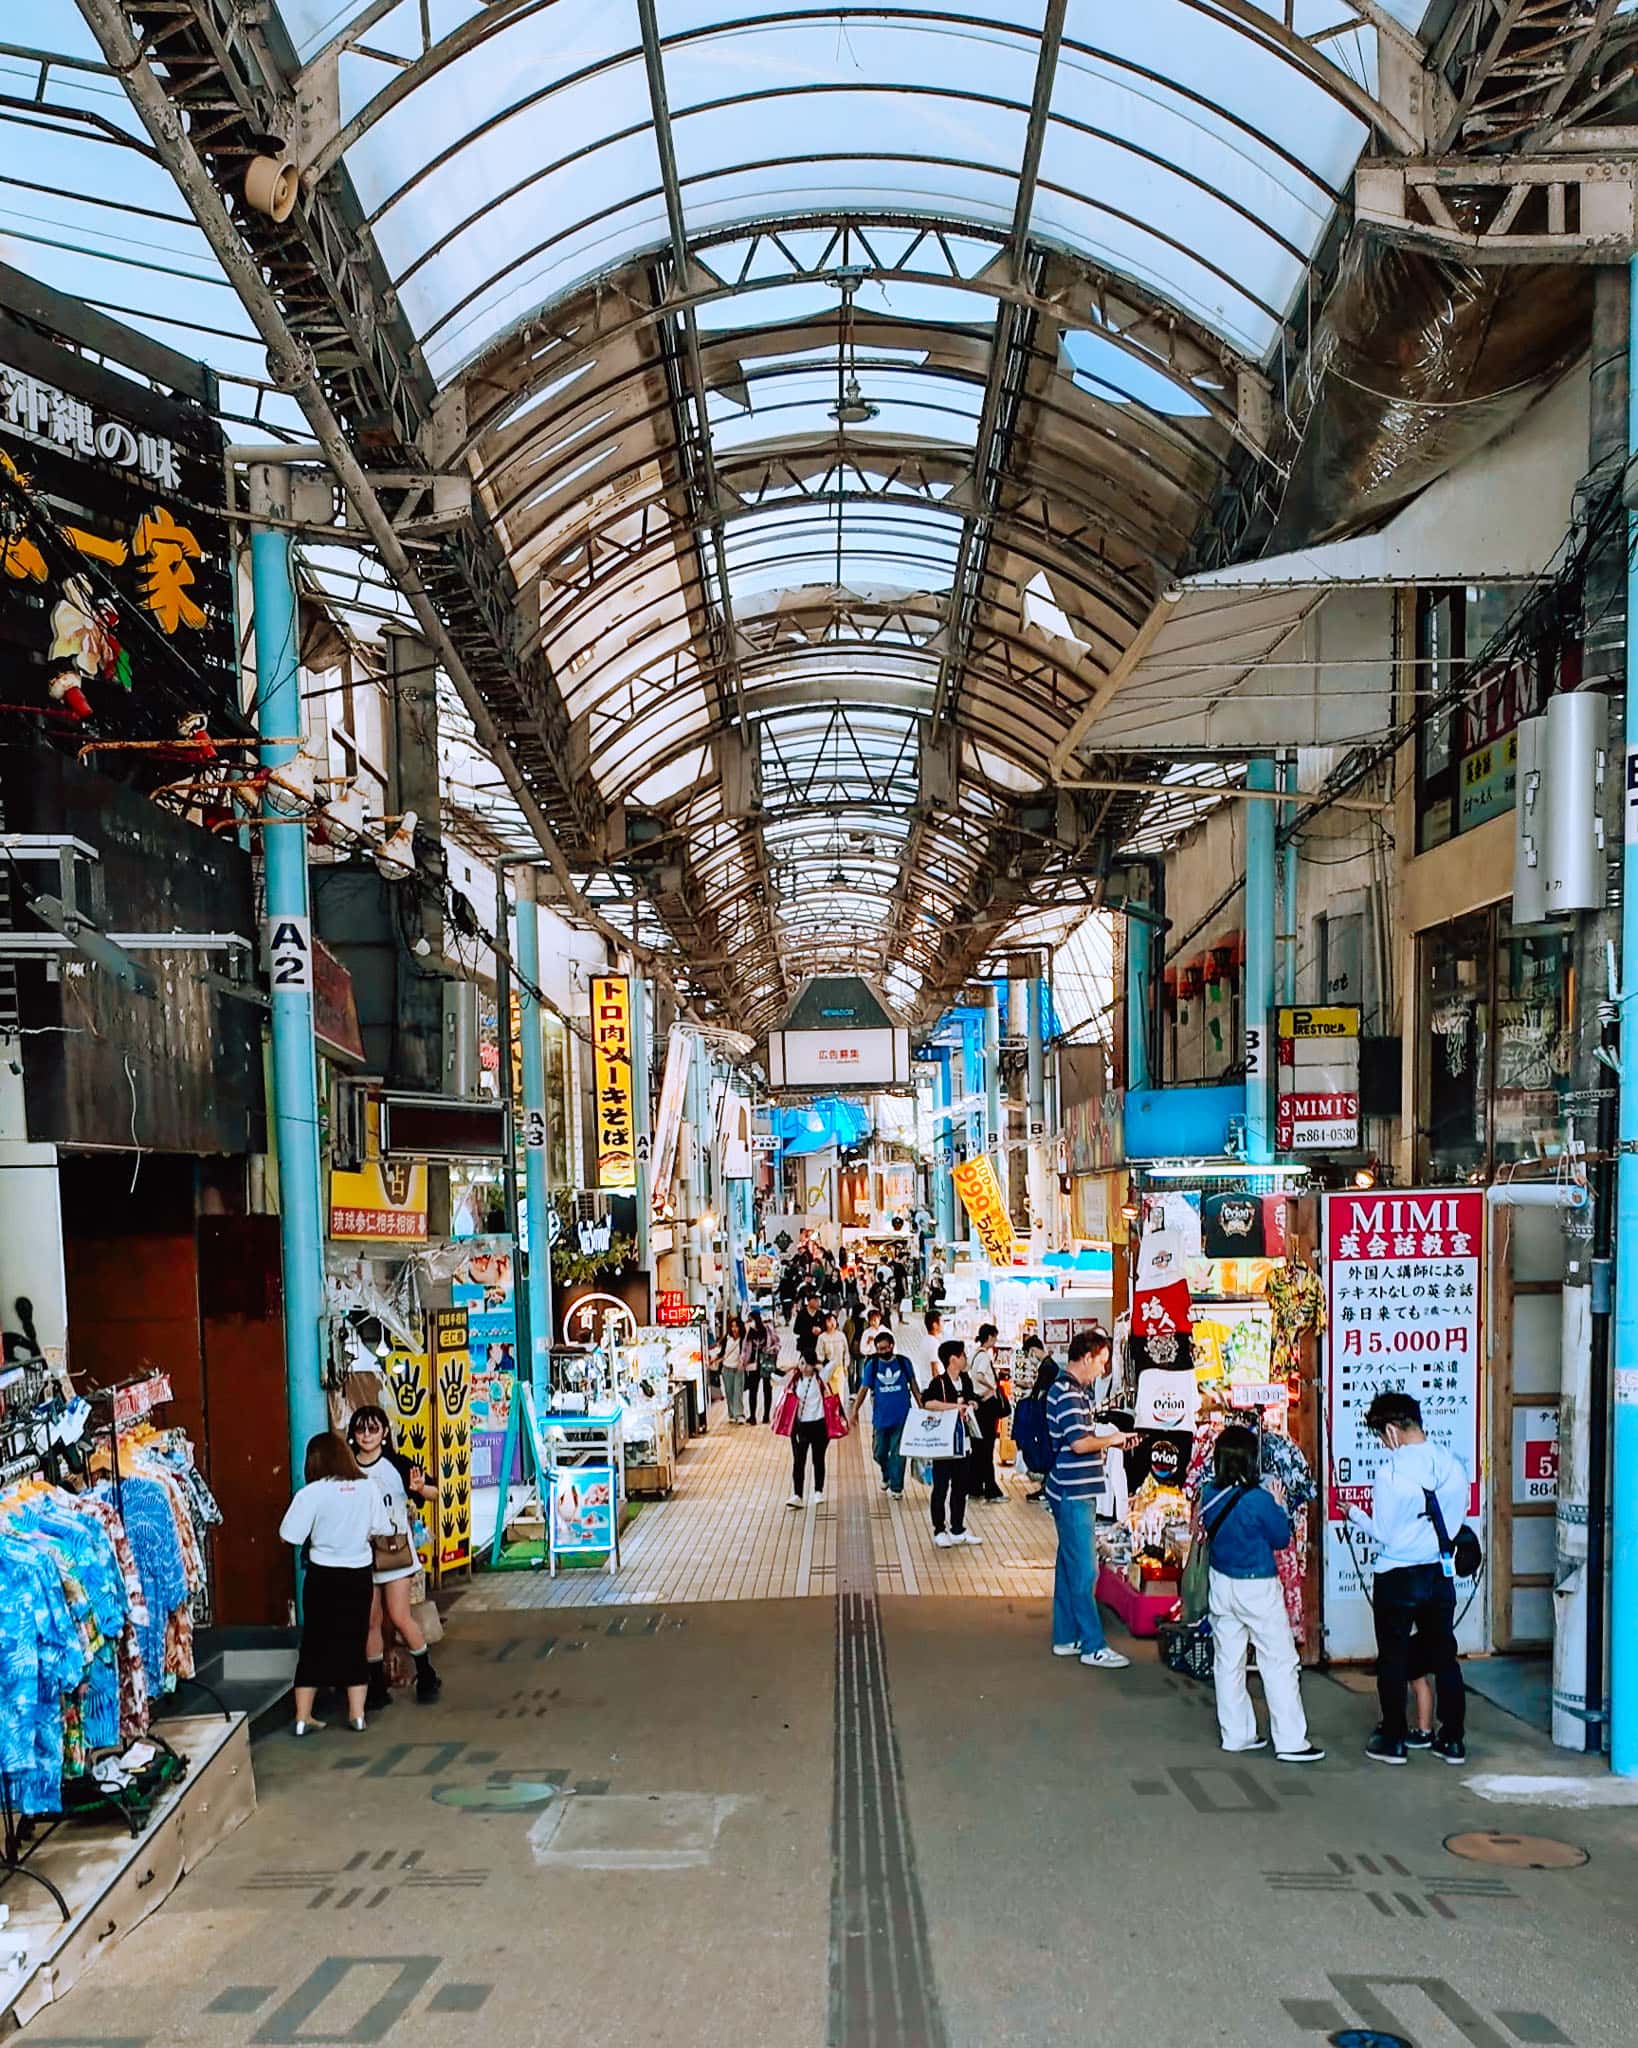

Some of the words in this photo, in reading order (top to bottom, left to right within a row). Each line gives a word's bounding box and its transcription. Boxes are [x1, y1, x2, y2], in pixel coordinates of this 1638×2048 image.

[270, 922, 307, 951] A
[274, 957, 305, 984] 2
[600, 981, 629, 1147] トロ肉ソーキそば
[1295, 1097, 1357, 1116] MIMI'S
[1350, 1200, 1460, 1233] MIMI
[1339, 1231, 1472, 1258] 英会話教室
[1348, 1263, 1465, 1280] 外国人講師による
[1337, 1283, 1474, 1300] テキストなしの英会話
[1340, 1305, 1420, 1321] 毎日来ても
